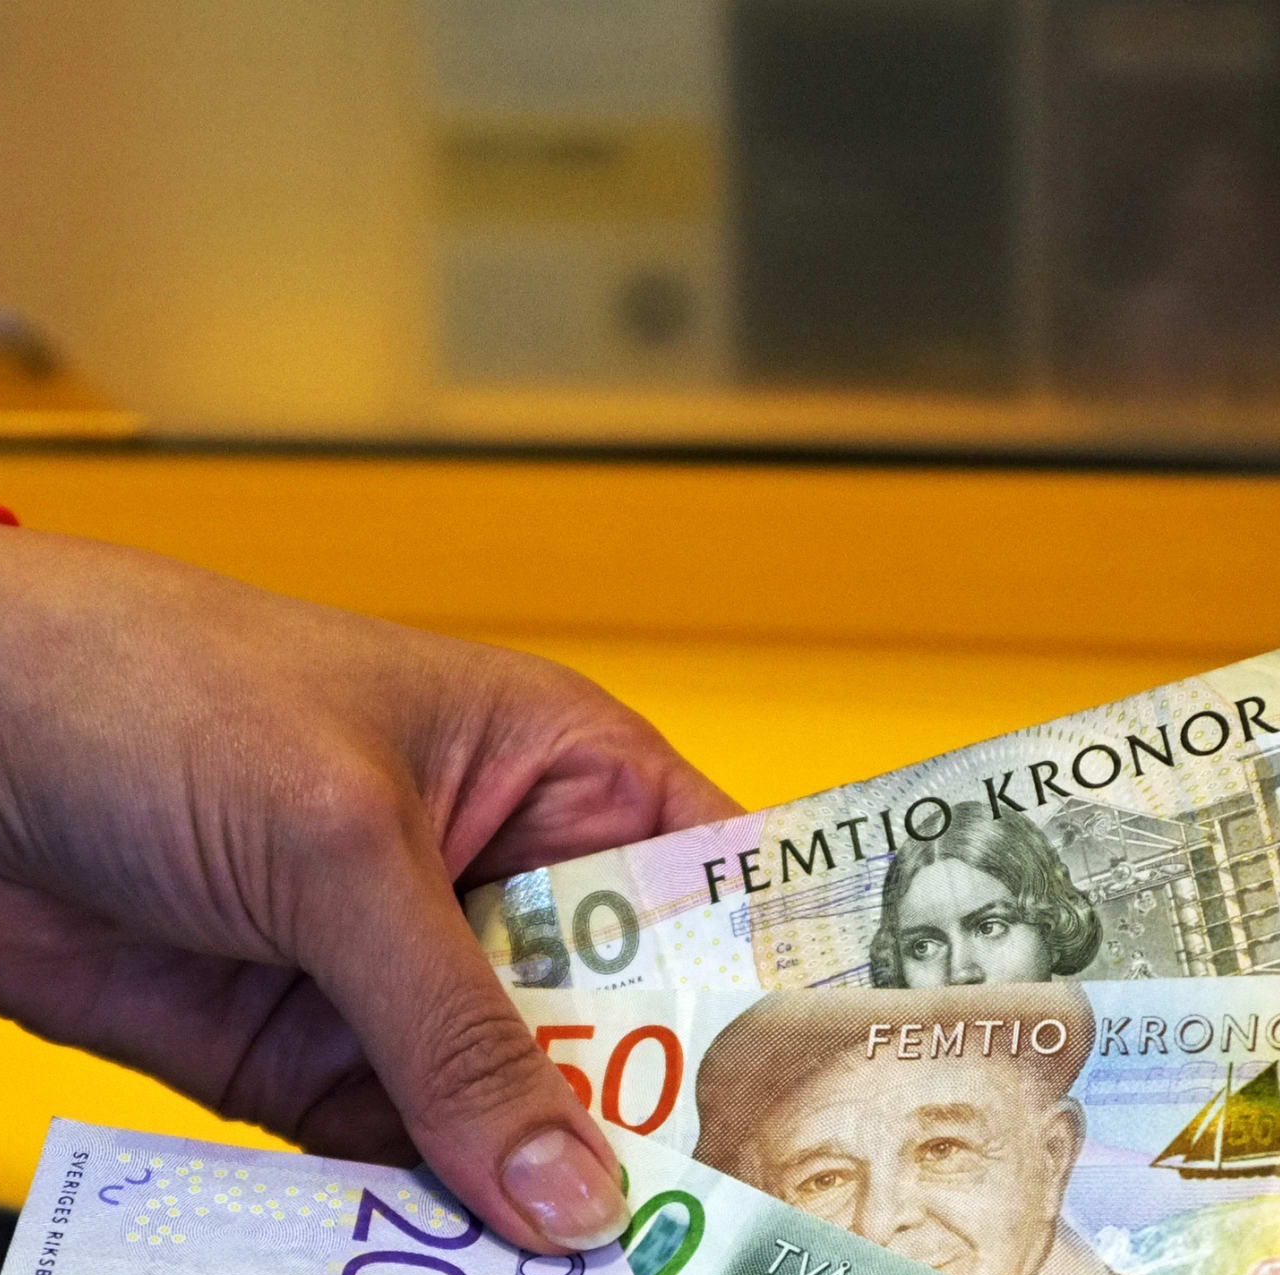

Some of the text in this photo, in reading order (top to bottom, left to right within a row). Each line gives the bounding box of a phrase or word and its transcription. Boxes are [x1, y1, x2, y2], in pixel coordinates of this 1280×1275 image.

[702, 695, 1280, 905] FEMTIO KRONOR
[506, 888, 640, 989] 50
[865, 1018, 1069, 1061] FEMTIO
[51, 1151, 89, 1225] SVERIGES
